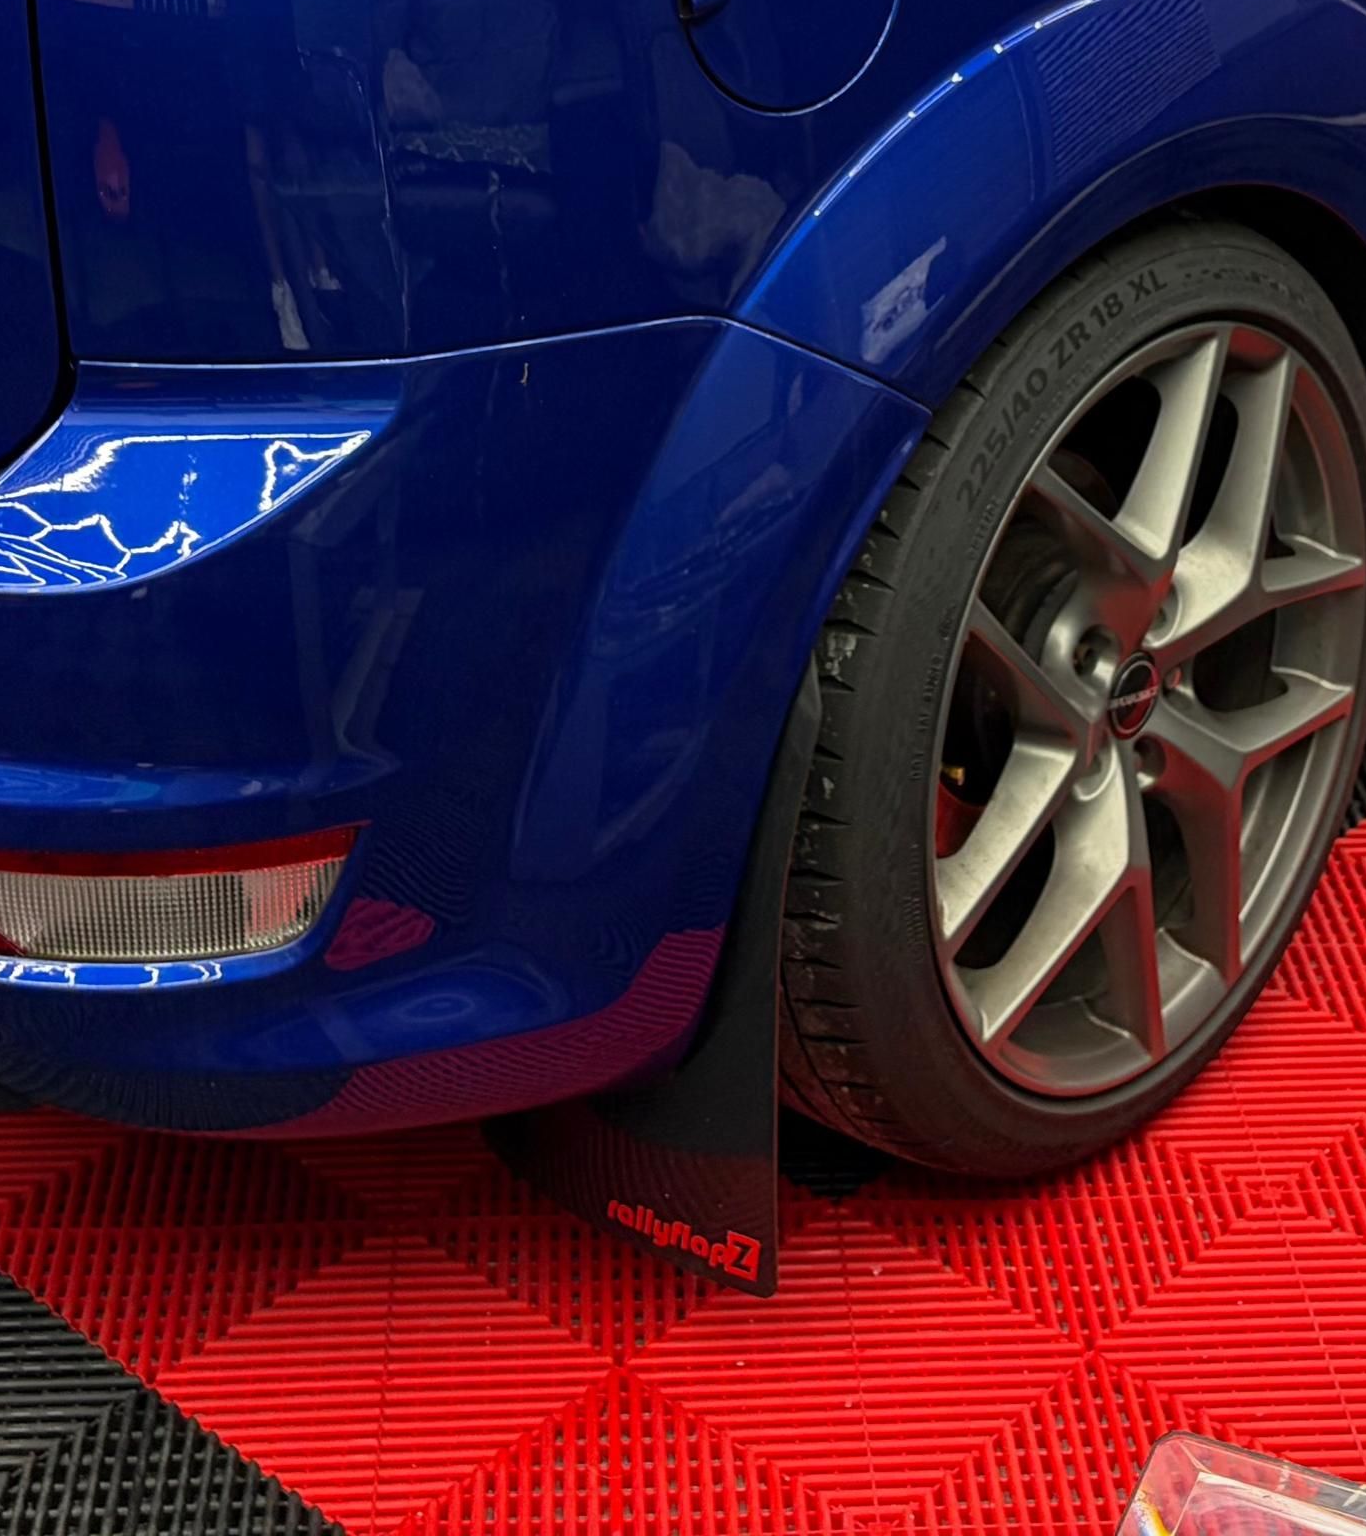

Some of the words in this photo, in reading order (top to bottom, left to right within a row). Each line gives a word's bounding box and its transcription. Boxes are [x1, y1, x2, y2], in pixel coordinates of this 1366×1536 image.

[956, 368, 1048, 513] 225/40
[1049, 327, 1092, 370] ZR
[1089, 291, 1124, 329] 18
[1126, 268, 1169, 304] XL
